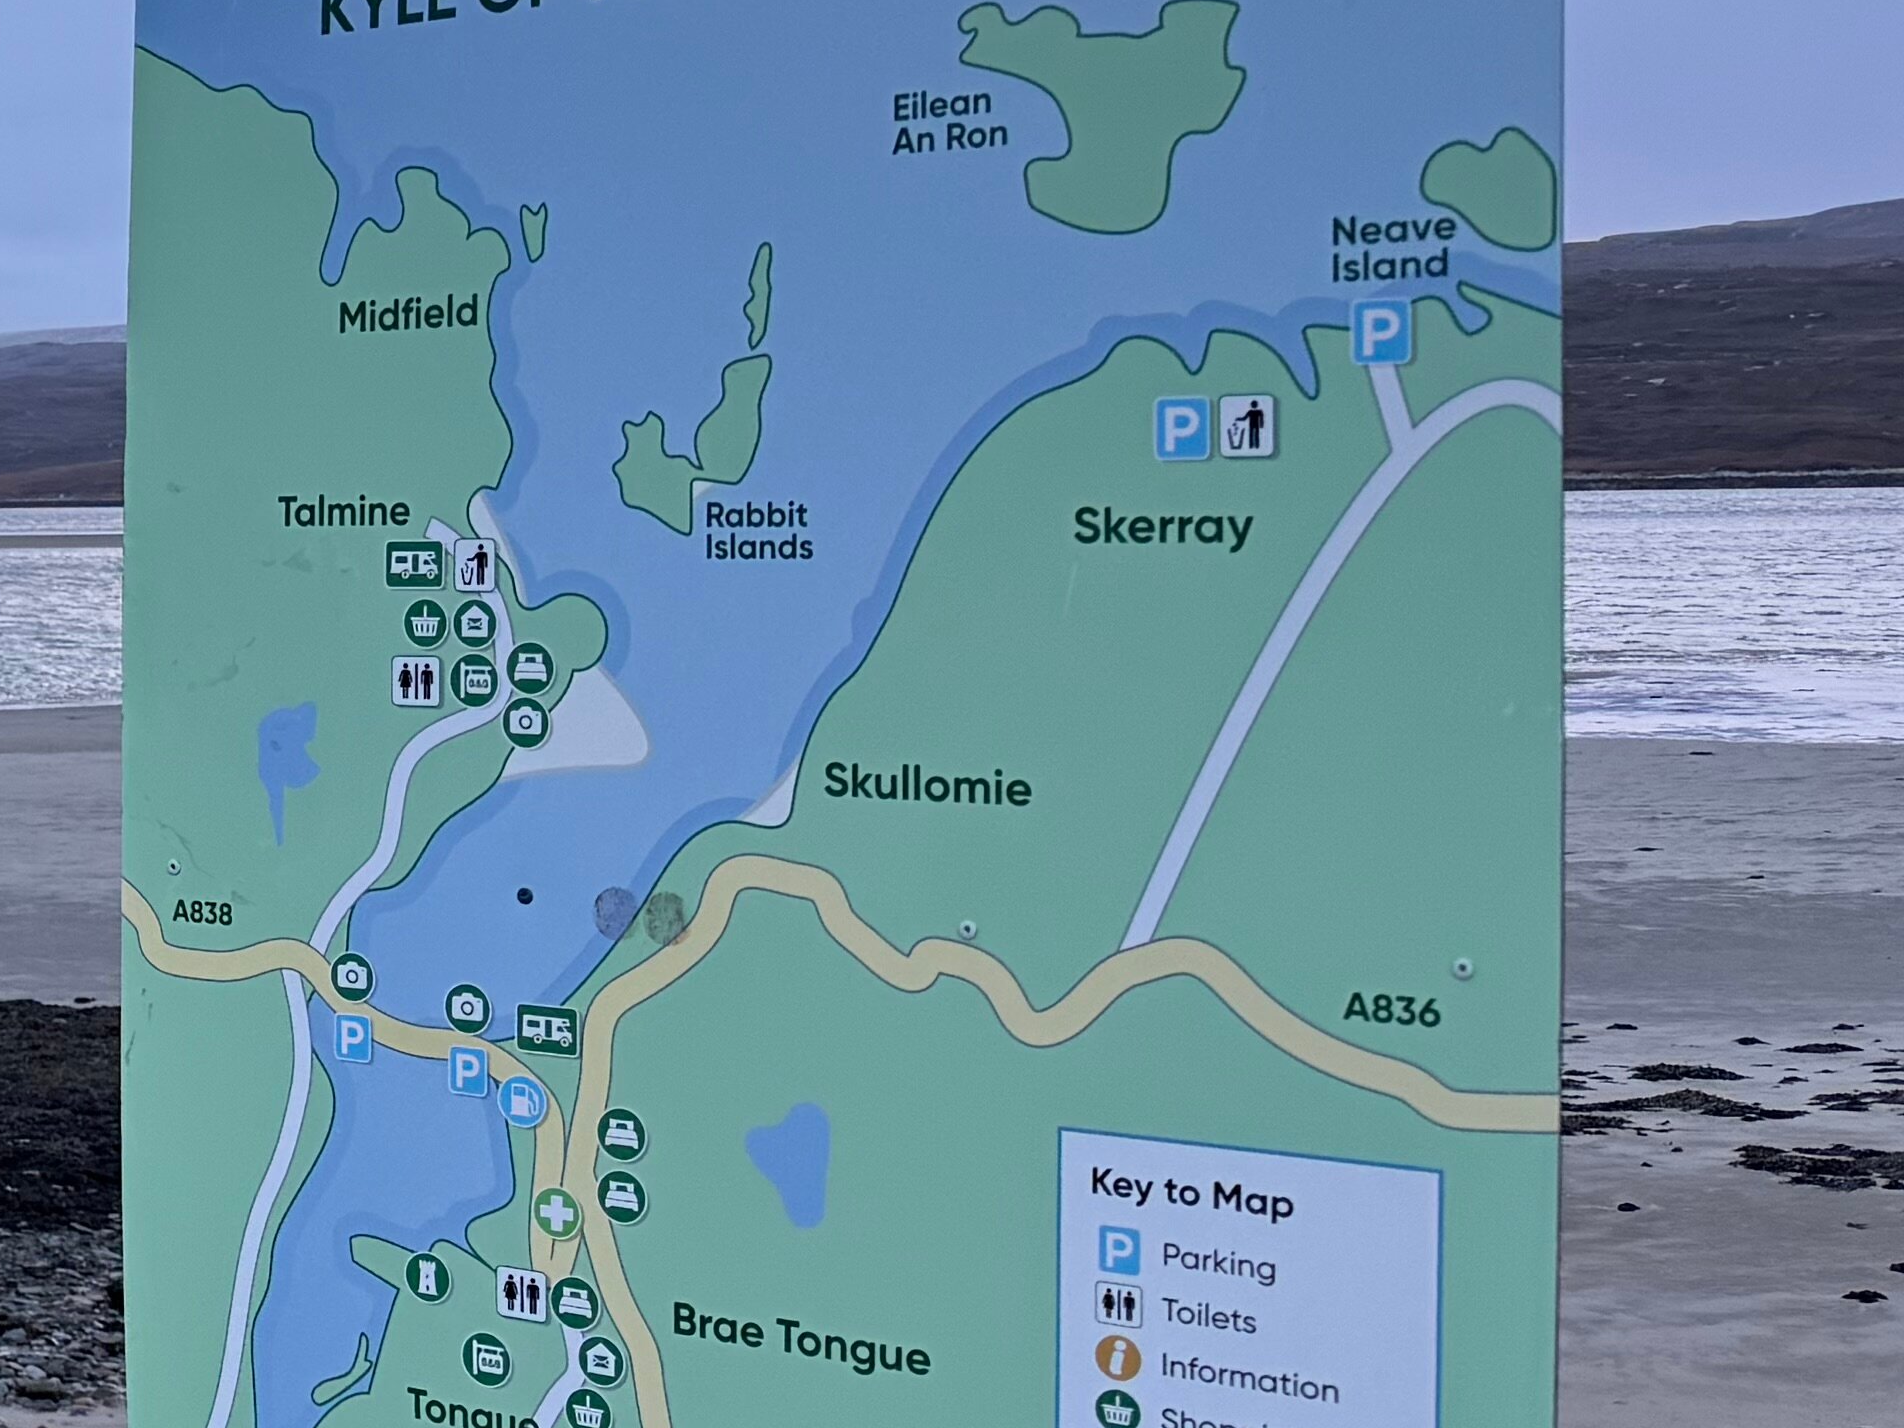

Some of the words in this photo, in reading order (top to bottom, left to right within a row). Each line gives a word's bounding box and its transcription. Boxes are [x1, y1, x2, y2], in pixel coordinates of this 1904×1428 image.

[893, 90, 992, 121] Eilean
[893, 125, 936, 155] An
[946, 121, 1008, 150] Ron
[1332, 214, 1457, 246] Neave
[1332, 250, 1450, 283] Island
[339, 294, 479, 333] Midfield
[1363, 308, 1400, 355] P
[1165, 406, 1199, 452] P
[278, 494, 411, 528] Talmine
[706, 501, 808, 530] Rabbit
[1073, 506, 1254, 553] Skerray
[706, 533, 814, 561] Islands
[823, 761, 1033, 807] Skullomie
[172, 899, 233, 927] A838
[1343, 992, 1442, 1028] A836
[1090, 1167, 1153, 1207] Key
[1164, 1177, 1200, 1207] to
[1212, 1181, 1294, 1224] Map
[1162, 1243, 1277, 1287] Parking
[1162, 1298, 1257, 1335] Toilets
[673, 1301, 764, 1348] Brae
[776, 1318, 931, 1376] Tongue
[1161, 1353, 1340, 1404] Information
